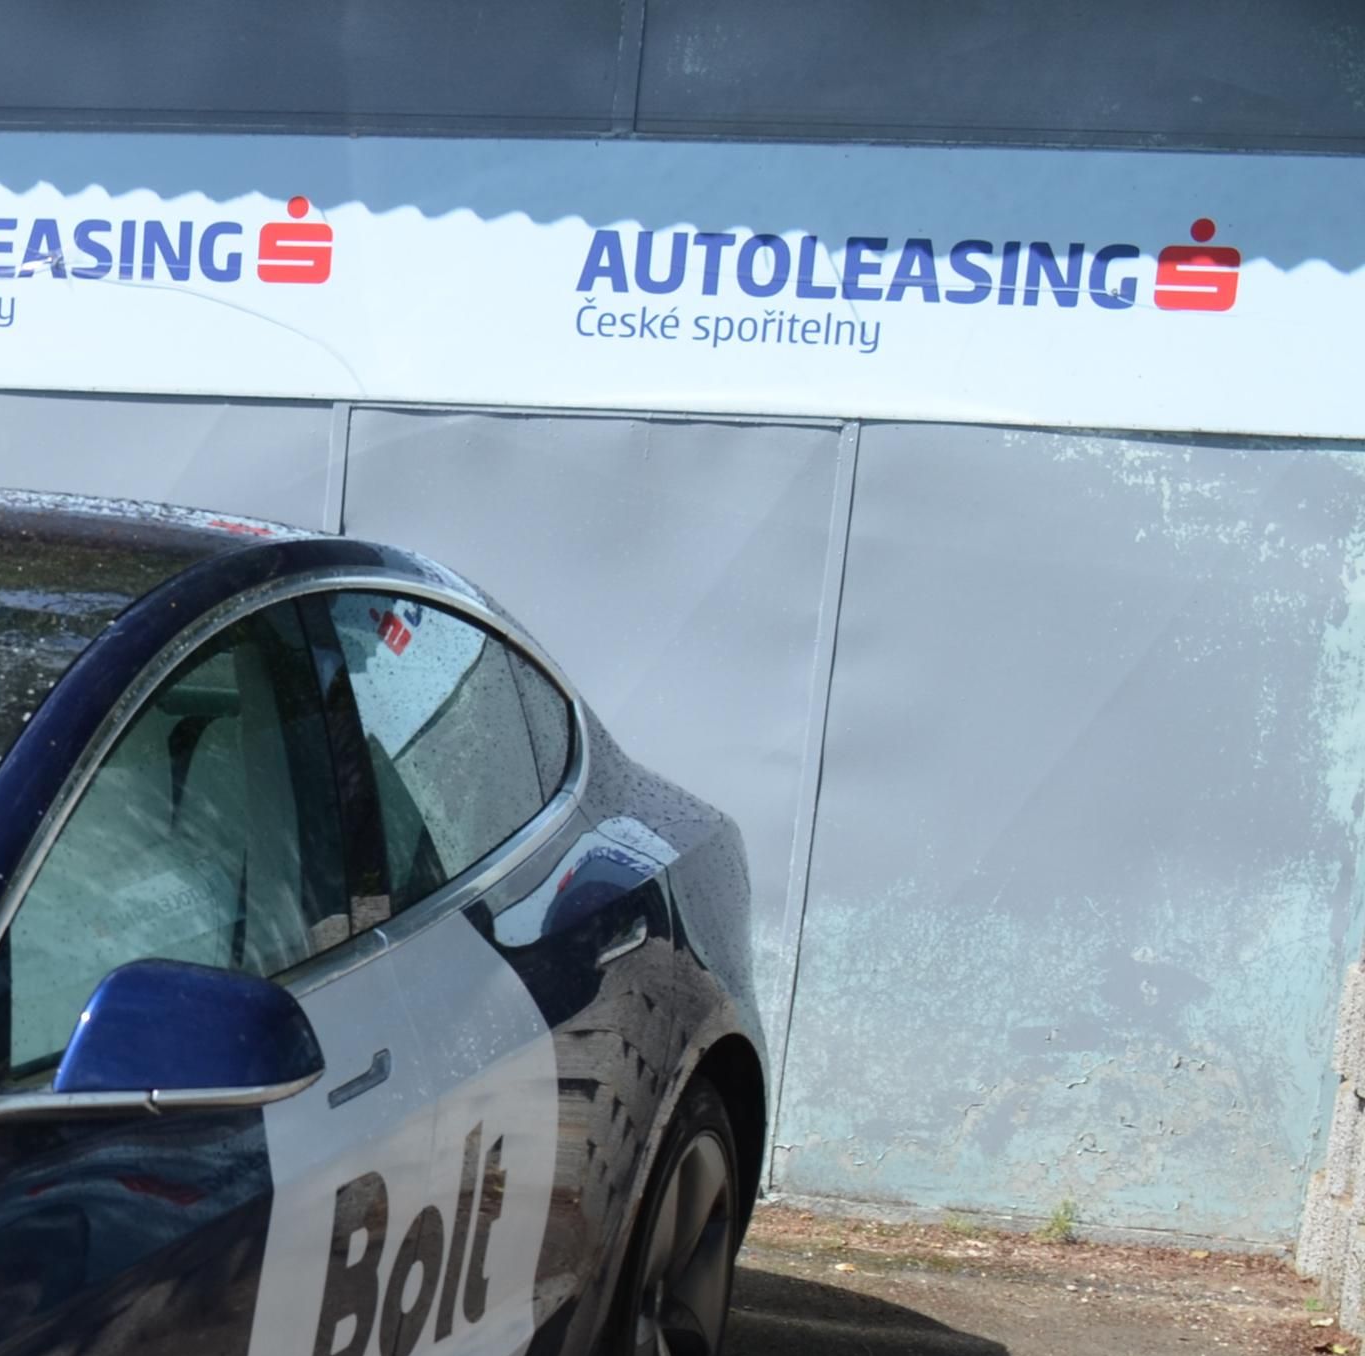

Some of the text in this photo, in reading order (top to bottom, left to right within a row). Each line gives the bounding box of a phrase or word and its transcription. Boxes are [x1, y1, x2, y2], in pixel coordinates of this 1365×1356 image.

[576, 230, 1140, 310] AUTOLEASING
[576, 297, 881, 353] České spořitelny
